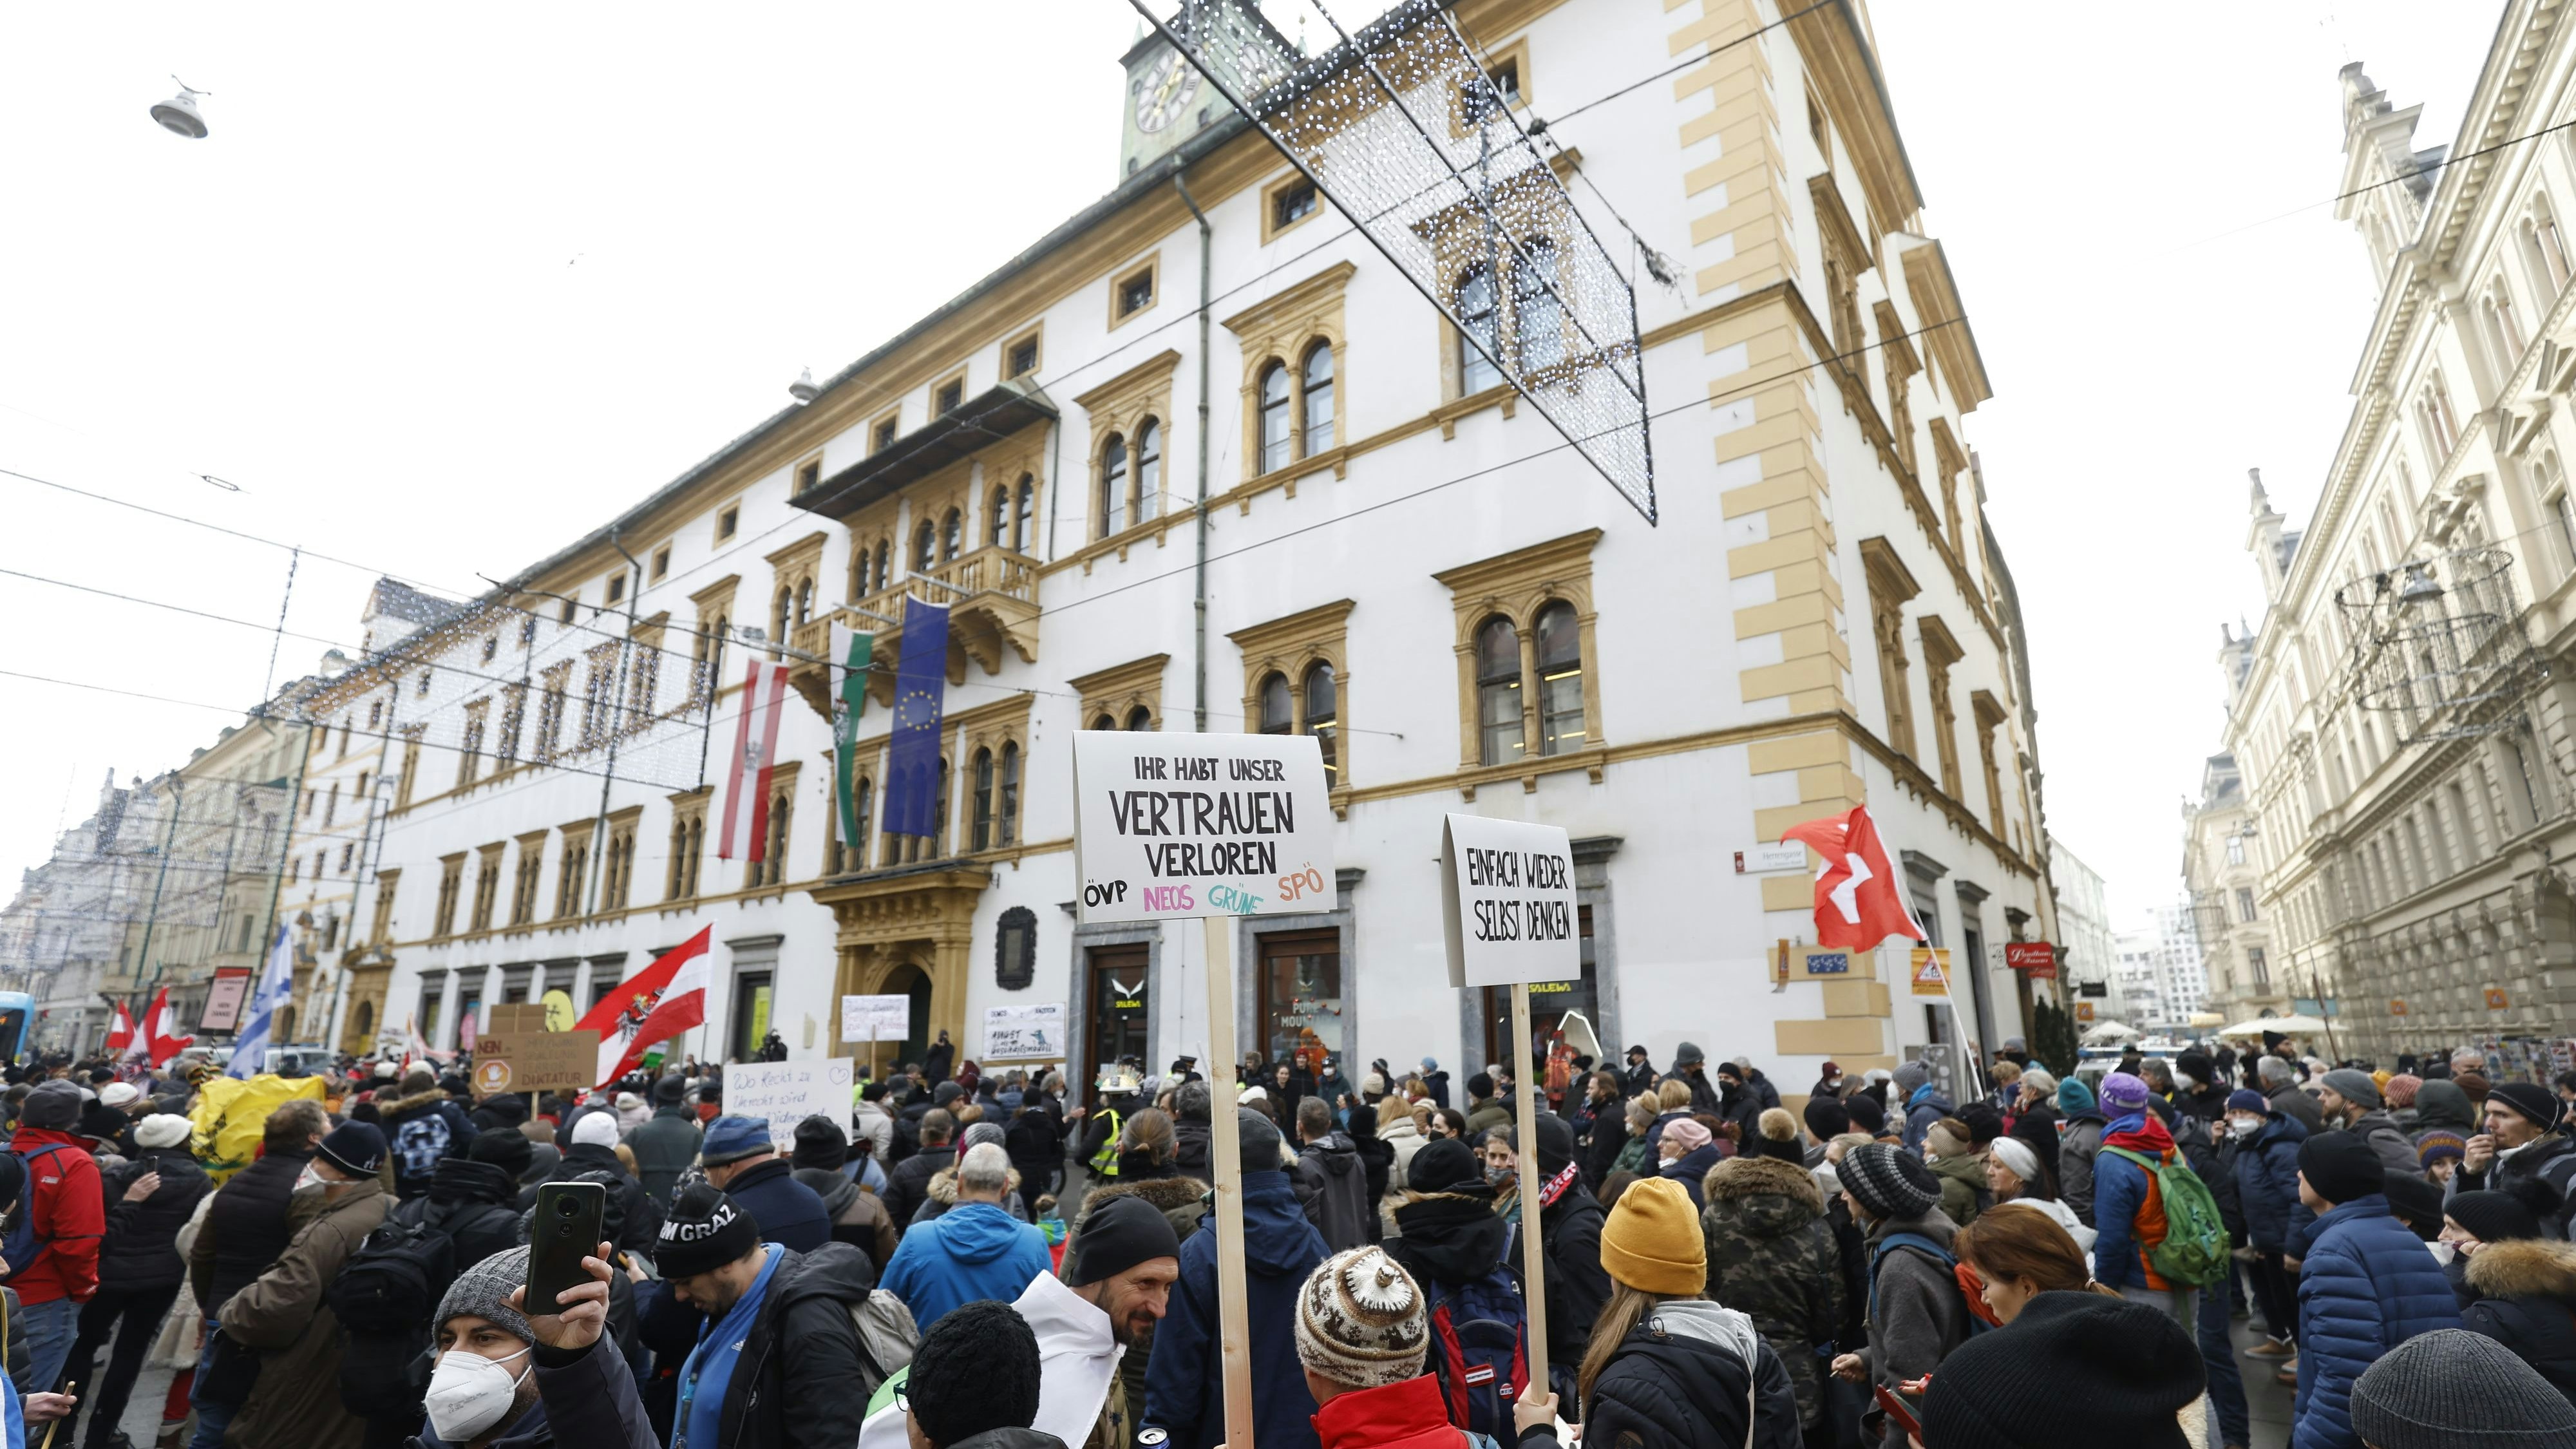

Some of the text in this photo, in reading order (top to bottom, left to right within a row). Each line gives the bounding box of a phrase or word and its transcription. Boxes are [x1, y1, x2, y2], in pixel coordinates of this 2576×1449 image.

[1135, 756, 1286, 781] IHR HABT UNSER
[1108, 790, 1294, 836] VERTRAUEN
[1144, 841, 1277, 877] VERLOREN
[1466, 848, 1569, 889] EINFACH WIEDER
[1084, 862, 1324, 915] ÖVP NEOS GRÜNE SPÖ
[1474, 900, 1571, 942] SELBST DENKEN
[1529, 982, 1571, 993] SALEWA
[522, 1072, 582, 1086] DIKTATUR
[733, 1072, 755, 1090] Wo
[680, 1204, 737, 1242] GRAZ
